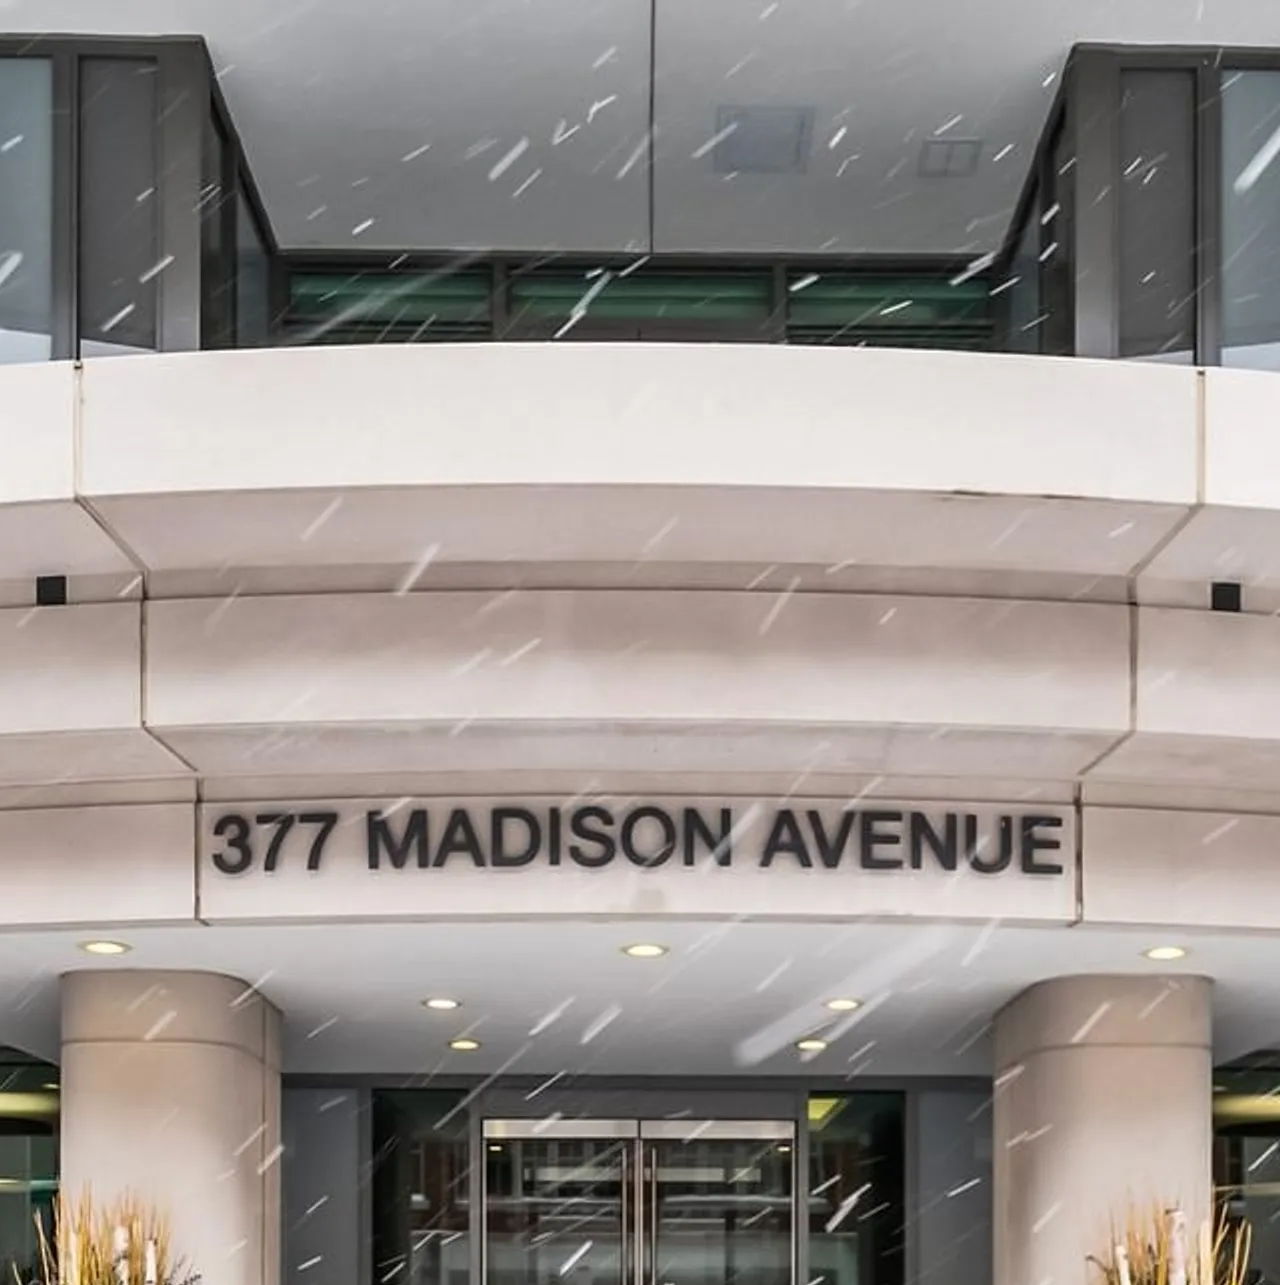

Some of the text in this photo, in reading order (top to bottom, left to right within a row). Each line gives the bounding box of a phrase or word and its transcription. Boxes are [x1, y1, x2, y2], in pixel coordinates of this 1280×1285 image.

[211, 804, 1063, 874] 377 MADISON AVENUE
